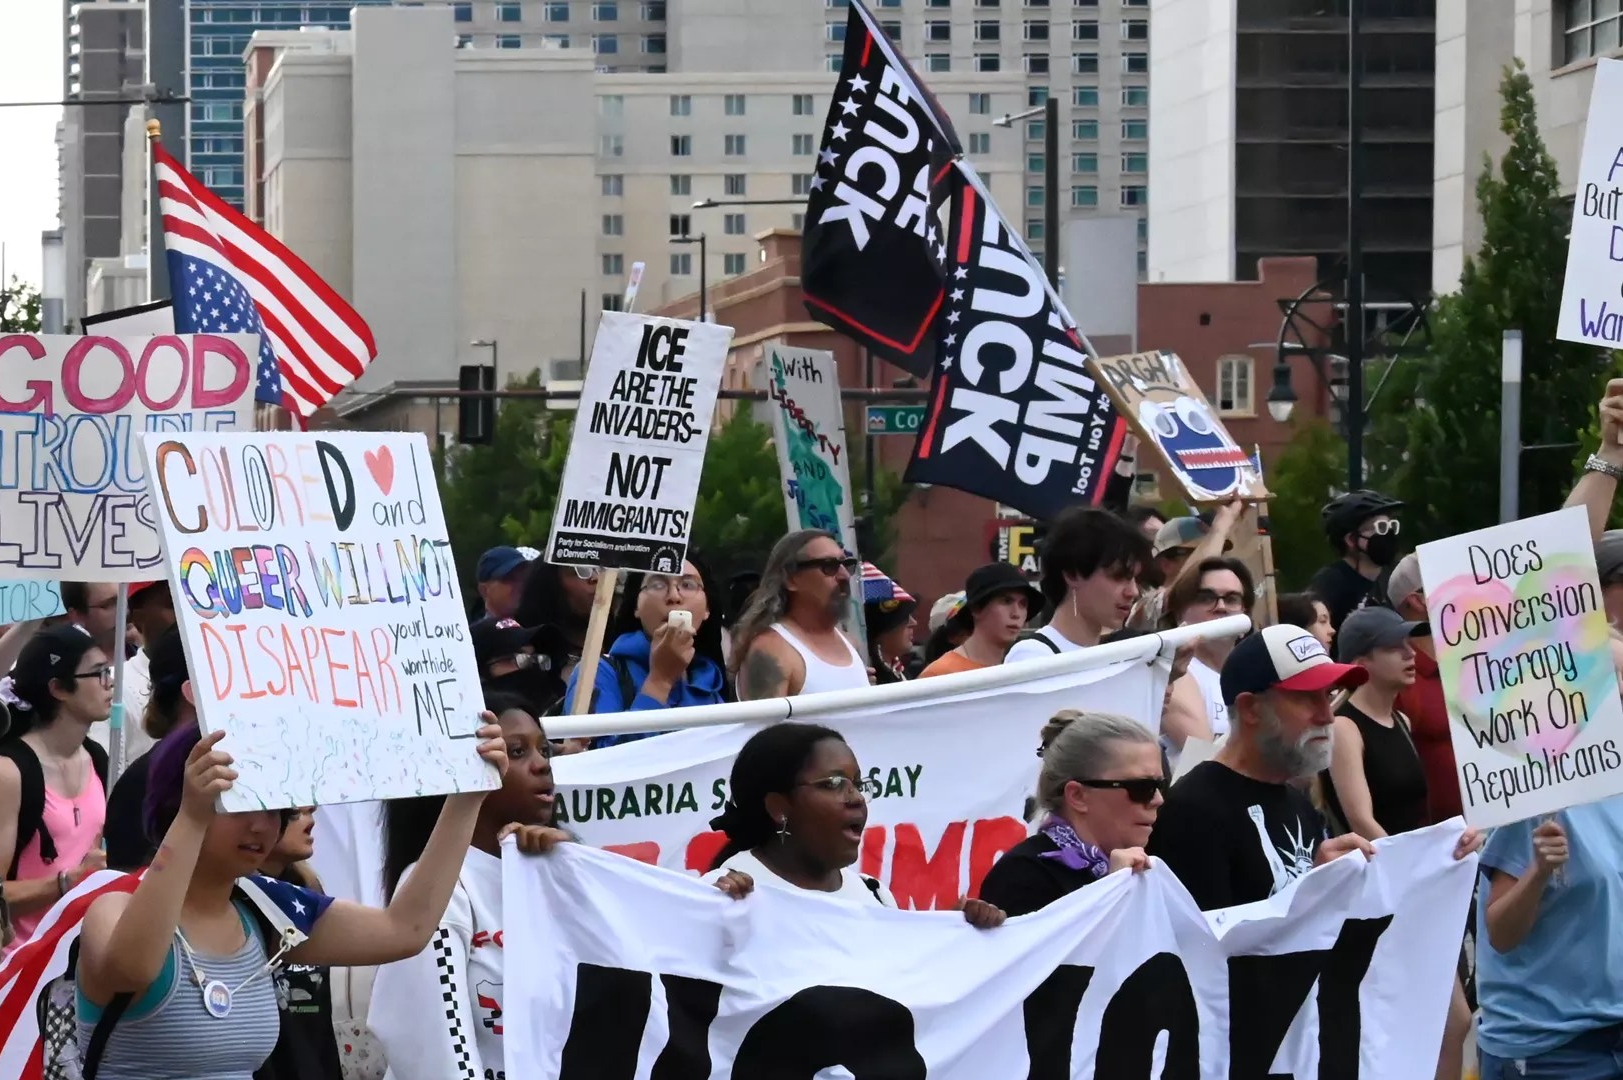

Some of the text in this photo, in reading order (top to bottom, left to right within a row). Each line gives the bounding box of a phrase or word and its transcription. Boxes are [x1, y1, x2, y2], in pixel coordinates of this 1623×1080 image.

[634, 324, 690, 373] ICE
[609, 370, 698, 409] ARE THE
[156, 440, 356, 534] COLORED
[373, 442, 426, 528] and
[605, 452, 672, 500] NOT
[793, 459, 826, 482] AND
[563, 499, 689, 539] IMMIGRANTS!
[180, 543, 313, 619] QUEER
[1441, 582, 1598, 647] Conversion
[200, 622, 403, 718] DISAPEAR
[413, 679, 476, 740] ME
[1548, 688, 1589, 730] On
[551, 782, 699, 824] AURARIA
